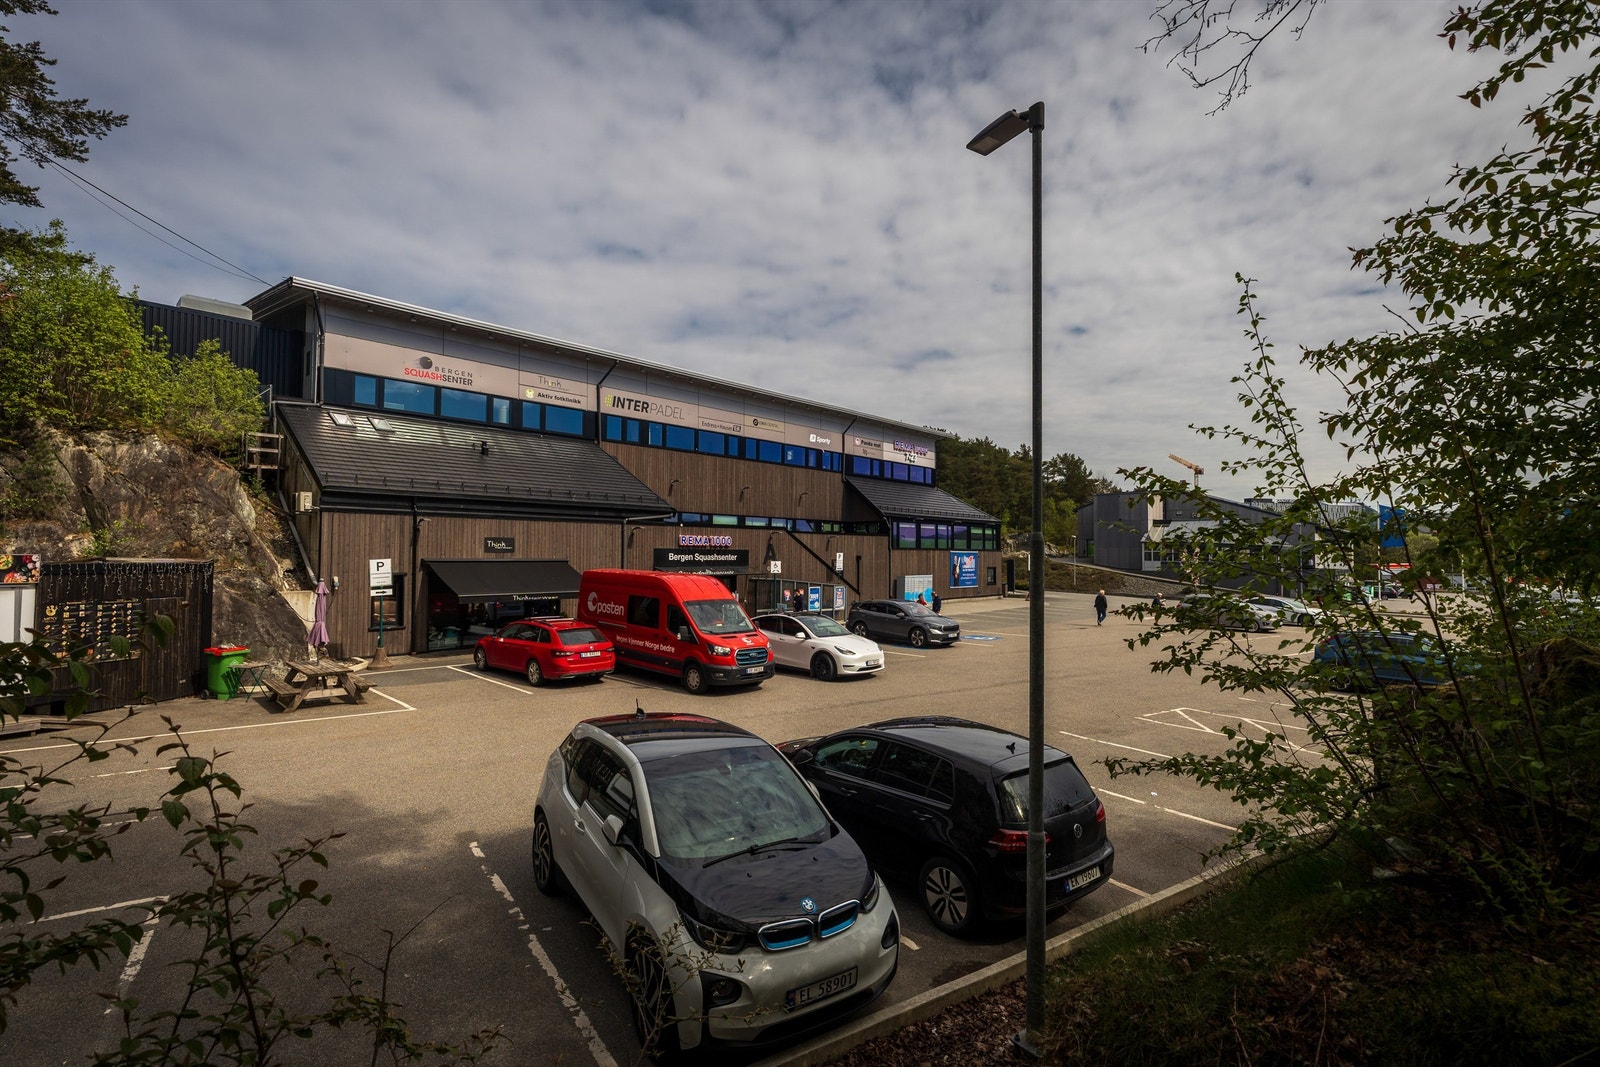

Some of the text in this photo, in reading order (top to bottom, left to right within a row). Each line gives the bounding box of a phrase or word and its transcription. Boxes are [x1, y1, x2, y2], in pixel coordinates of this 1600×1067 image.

[404, 367, 474, 386] SQUASHSENTER
[434, 366, 473, 378] BERGEN
[537, 392, 553, 400] Aktiv
[817, 436, 831, 445] Sporty
[486, 540, 506, 548] Think
[679, 534, 733, 547] REMA 1000
[668, 553, 738, 562] Bergen Squashsenter
[376, 561, 385, 572] P
[596, 601, 625, 616] posten
[645, 641, 660, 651] Norge
[660, 644, 676, 653] bedre
[1070, 876, 1080, 888] EK
[799, 971, 853, 1004] EL 58901
